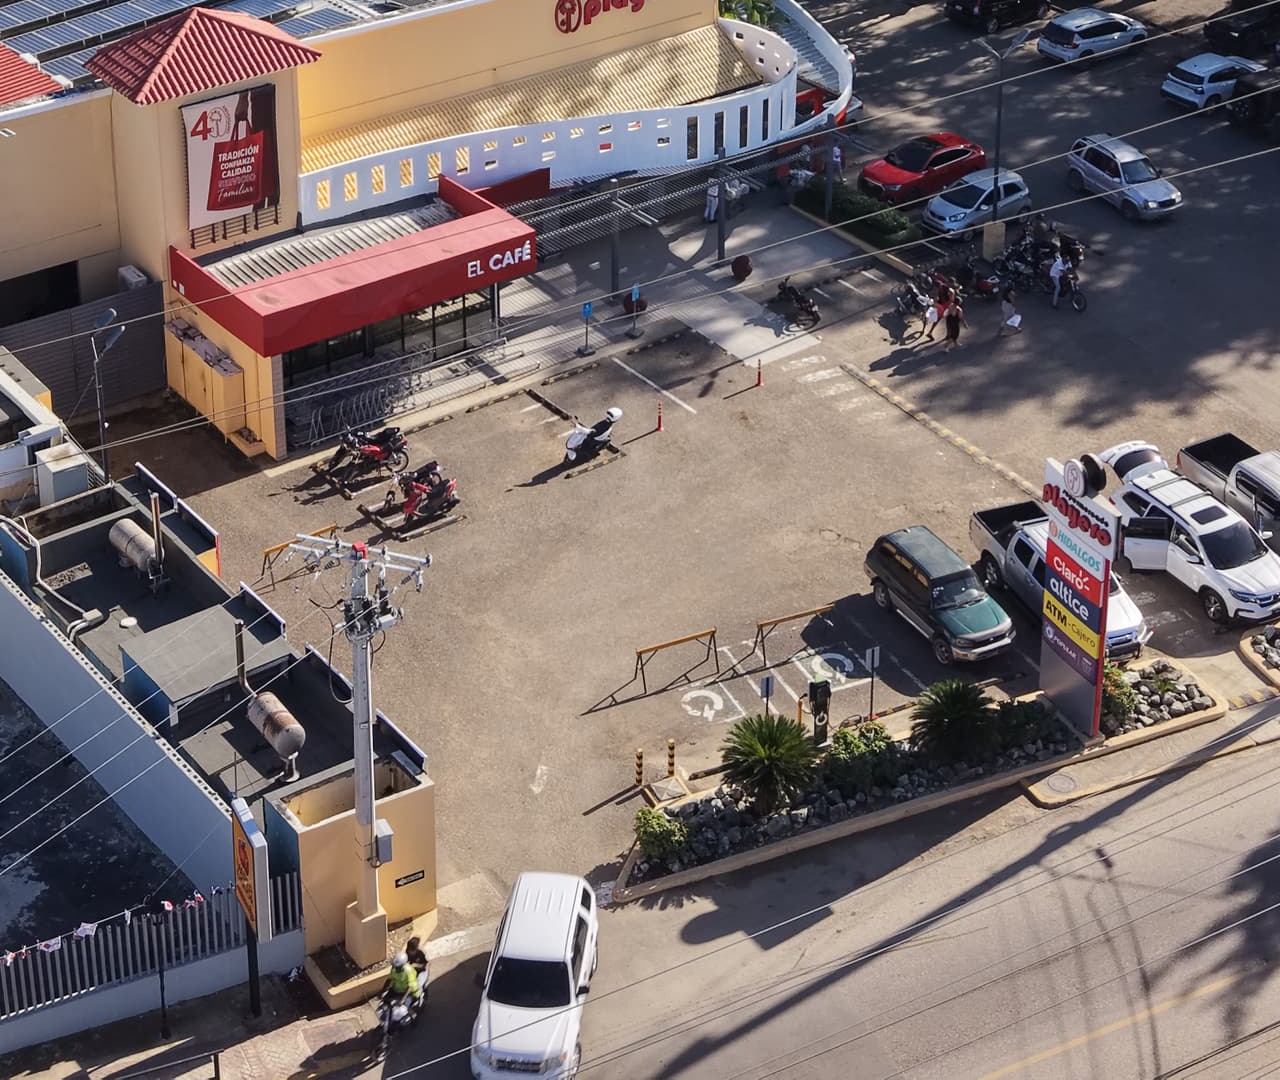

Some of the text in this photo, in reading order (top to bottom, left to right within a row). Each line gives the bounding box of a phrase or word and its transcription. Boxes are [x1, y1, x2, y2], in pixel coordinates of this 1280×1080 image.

[218, 144, 259, 163] TRADICIÓN
[220, 156, 255, 171] CONFIANZA
[221, 165, 252, 179] CALIDAD
[467, 240, 531, 278] EL CAFÉ
[1043, 483, 1112, 546] playero
[1058, 530, 1101, 572] HIDALGOS
[1053, 556, 1085, 591] Claro
[1046, 600, 1067, 627] ATM
[1050, 578, 1089, 621] altice
